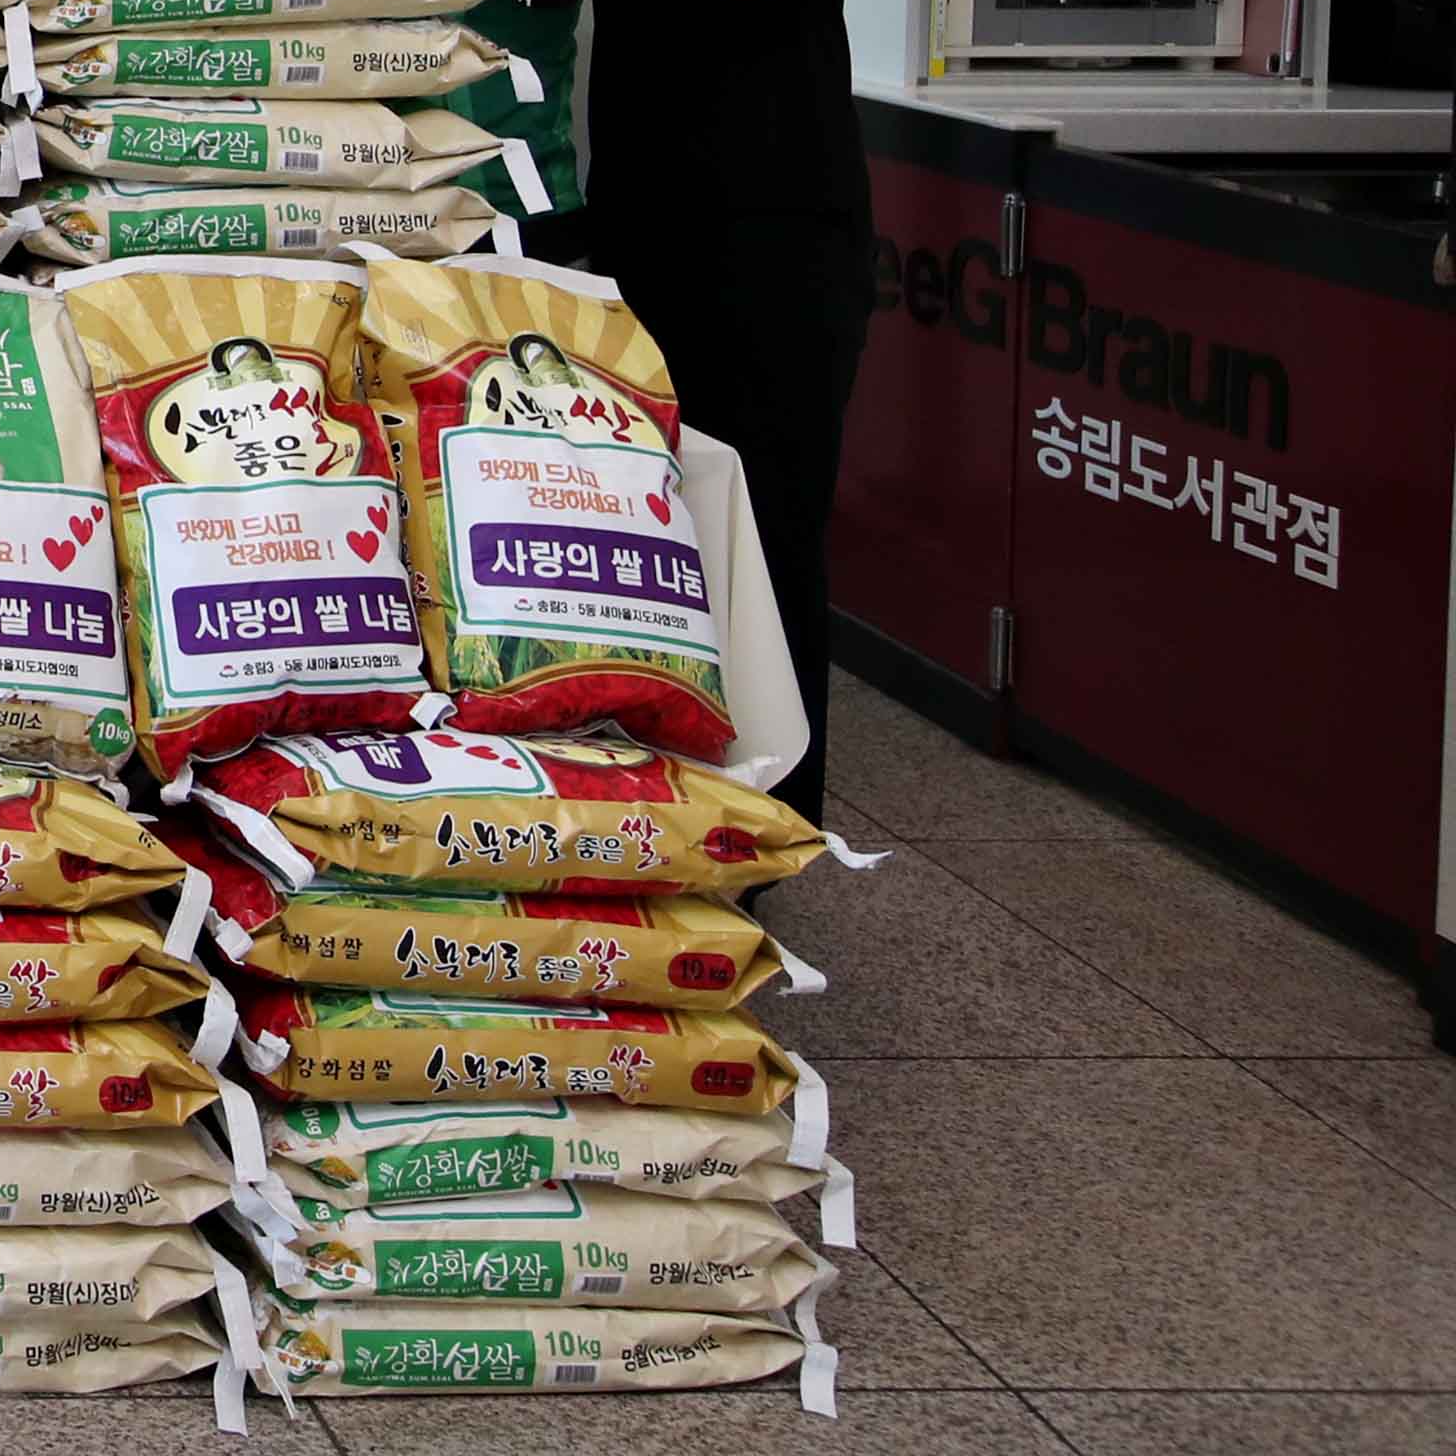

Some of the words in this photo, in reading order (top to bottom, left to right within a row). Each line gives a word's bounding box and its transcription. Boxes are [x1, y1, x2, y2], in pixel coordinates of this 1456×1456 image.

[477, 458, 541, 485] 맛있게
[545, 461, 602, 490] 드시고
[1032, 395, 1341, 590] 송림도서관점
[527, 486, 622, 514] 건강하세요
[490, 538, 601, 585] 사랑의
[611, 542, 645, 587] 쌀
[654, 553, 706, 601] 나눔
[42, 595, 107, 644] 나눔
[194, 596, 301, 643] 사랑의
[313, 592, 351, 636] 쌀
[362, 586, 415, 636] 나눔
[96, 720, 132, 743] 10kg
